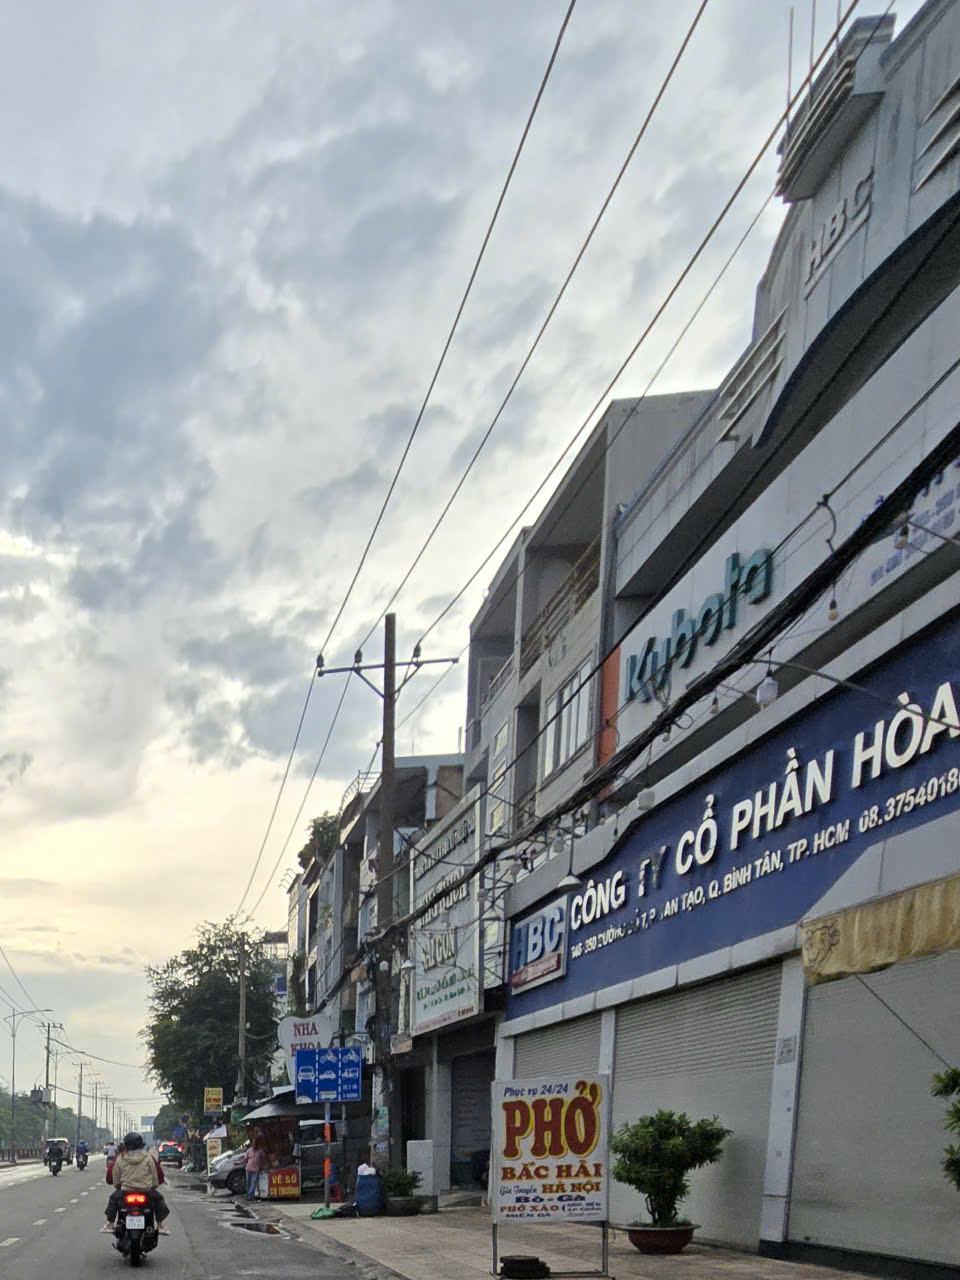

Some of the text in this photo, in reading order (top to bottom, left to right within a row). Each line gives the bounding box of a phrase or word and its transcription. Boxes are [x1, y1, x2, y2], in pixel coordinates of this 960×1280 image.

[571, 871, 625, 930] CÔNG
[676, 794, 718, 875] CỔ
[730, 748, 834, 851] PHẦN
[724, 864, 752, 893] BÌNH
[788, 838, 810, 864] TP.
[813, 819, 850, 854] HCM
[858, 767, 960, 834] 08.3754018
[514, 906, 565, 970] HBC
[293, 1022, 319, 1037] NHA
[504, 1087, 525, 1098] Phục
[541, 1083, 569, 1095] 24/24
[502, 1080, 602, 1160] PHỞ
[501, 1161, 550, 1181] BẮC
[570, 1180, 601, 1195] NỘI
